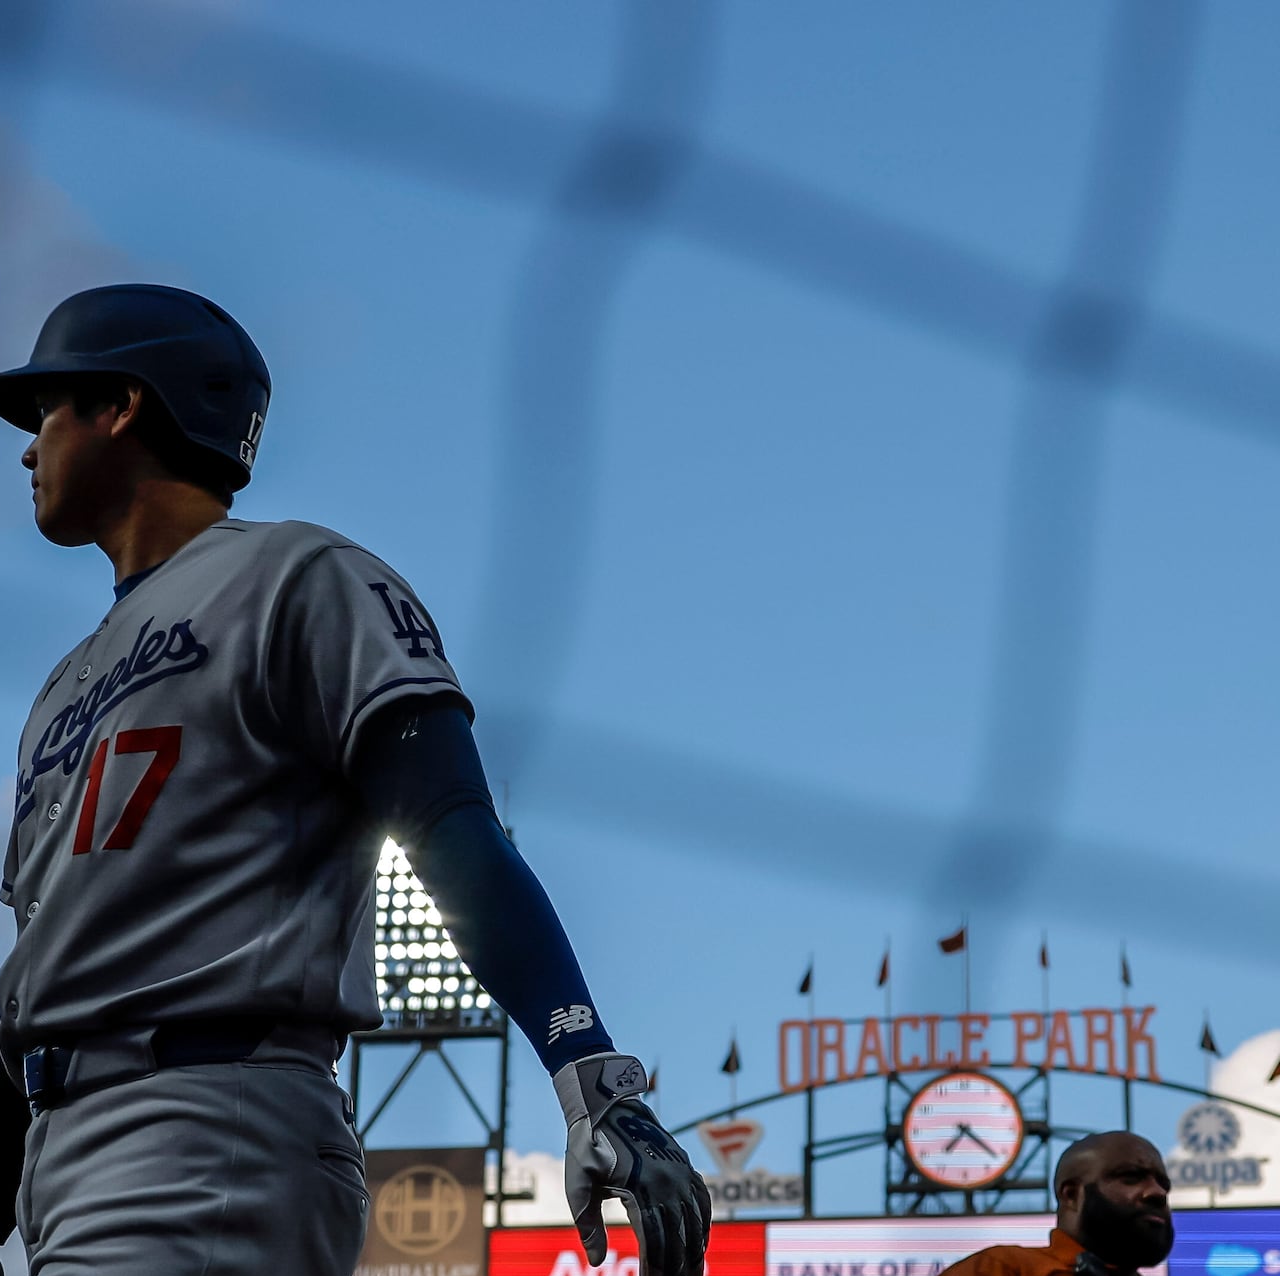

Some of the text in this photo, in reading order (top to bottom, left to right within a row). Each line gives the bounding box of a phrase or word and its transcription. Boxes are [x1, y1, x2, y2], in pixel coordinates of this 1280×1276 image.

[72, 726, 184, 855] 17
[779, 1006, 1161, 1094] ORACLE PARK
[709, 1176, 802, 1203] natics
